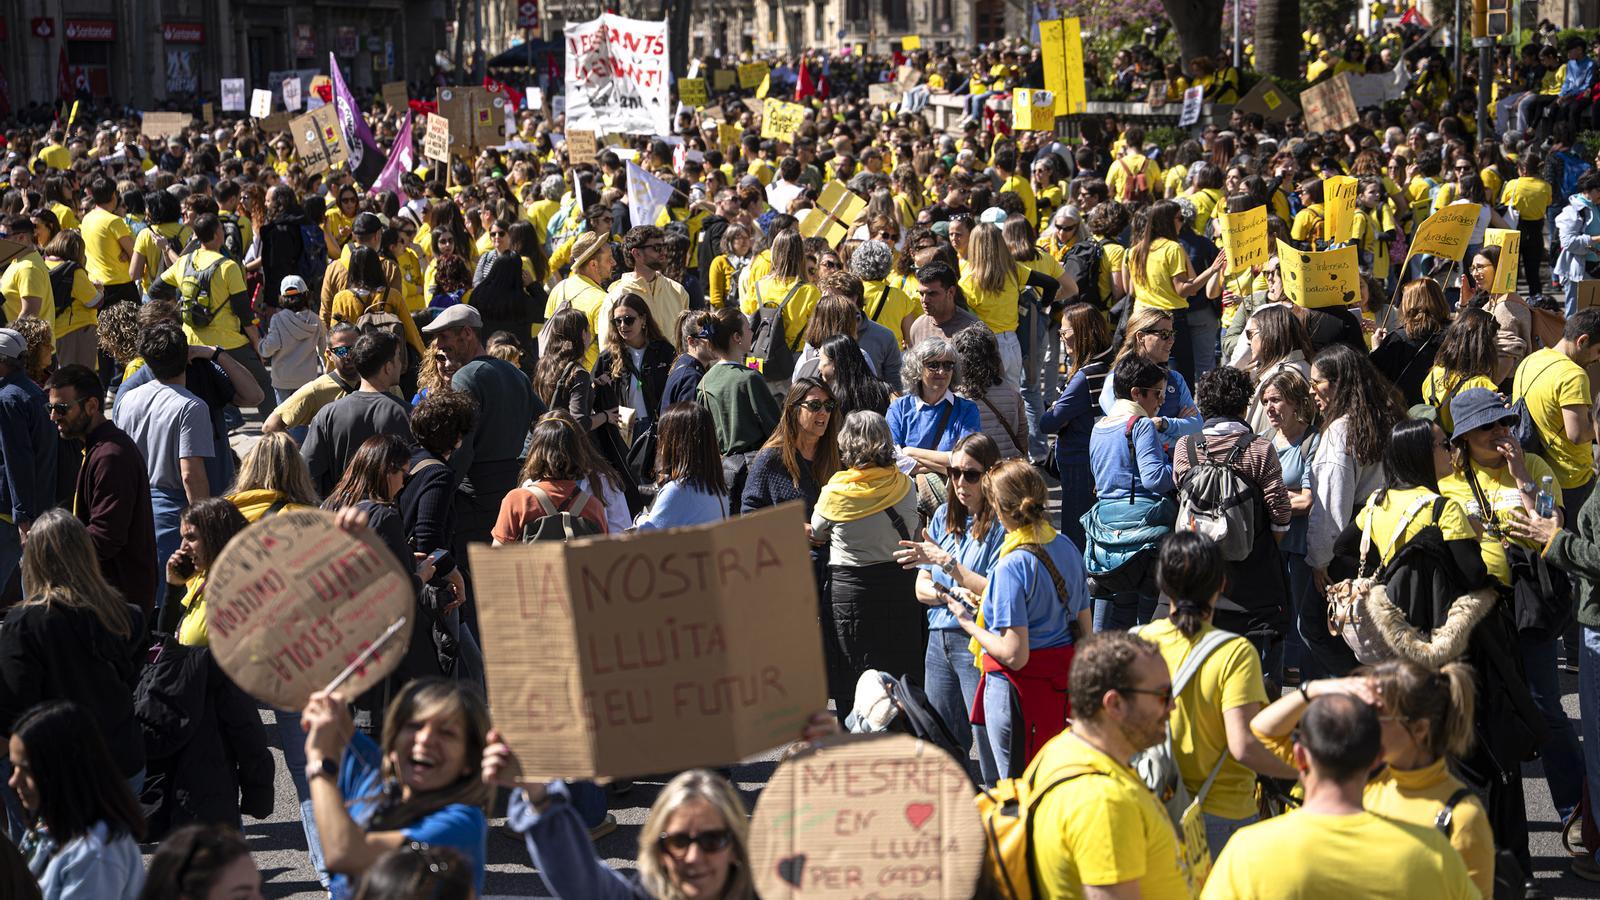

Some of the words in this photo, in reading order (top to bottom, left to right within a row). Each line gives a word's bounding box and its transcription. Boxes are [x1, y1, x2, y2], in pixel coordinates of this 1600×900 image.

[77, 25, 112, 38] Santander
[172, 29, 200, 40] Santander
[515, 559, 571, 620] LA
[581, 536, 783, 613] NOSTRA
[269, 616, 345, 682] ESCOLA
[583, 686, 654, 734] SEU
[674, 664, 789, 719] FUTUR
[802, 757, 965, 798] MESTRES
[834, 808, 877, 836] EN
[810, 865, 865, 890] PER
[878, 864, 943, 889] CADA
